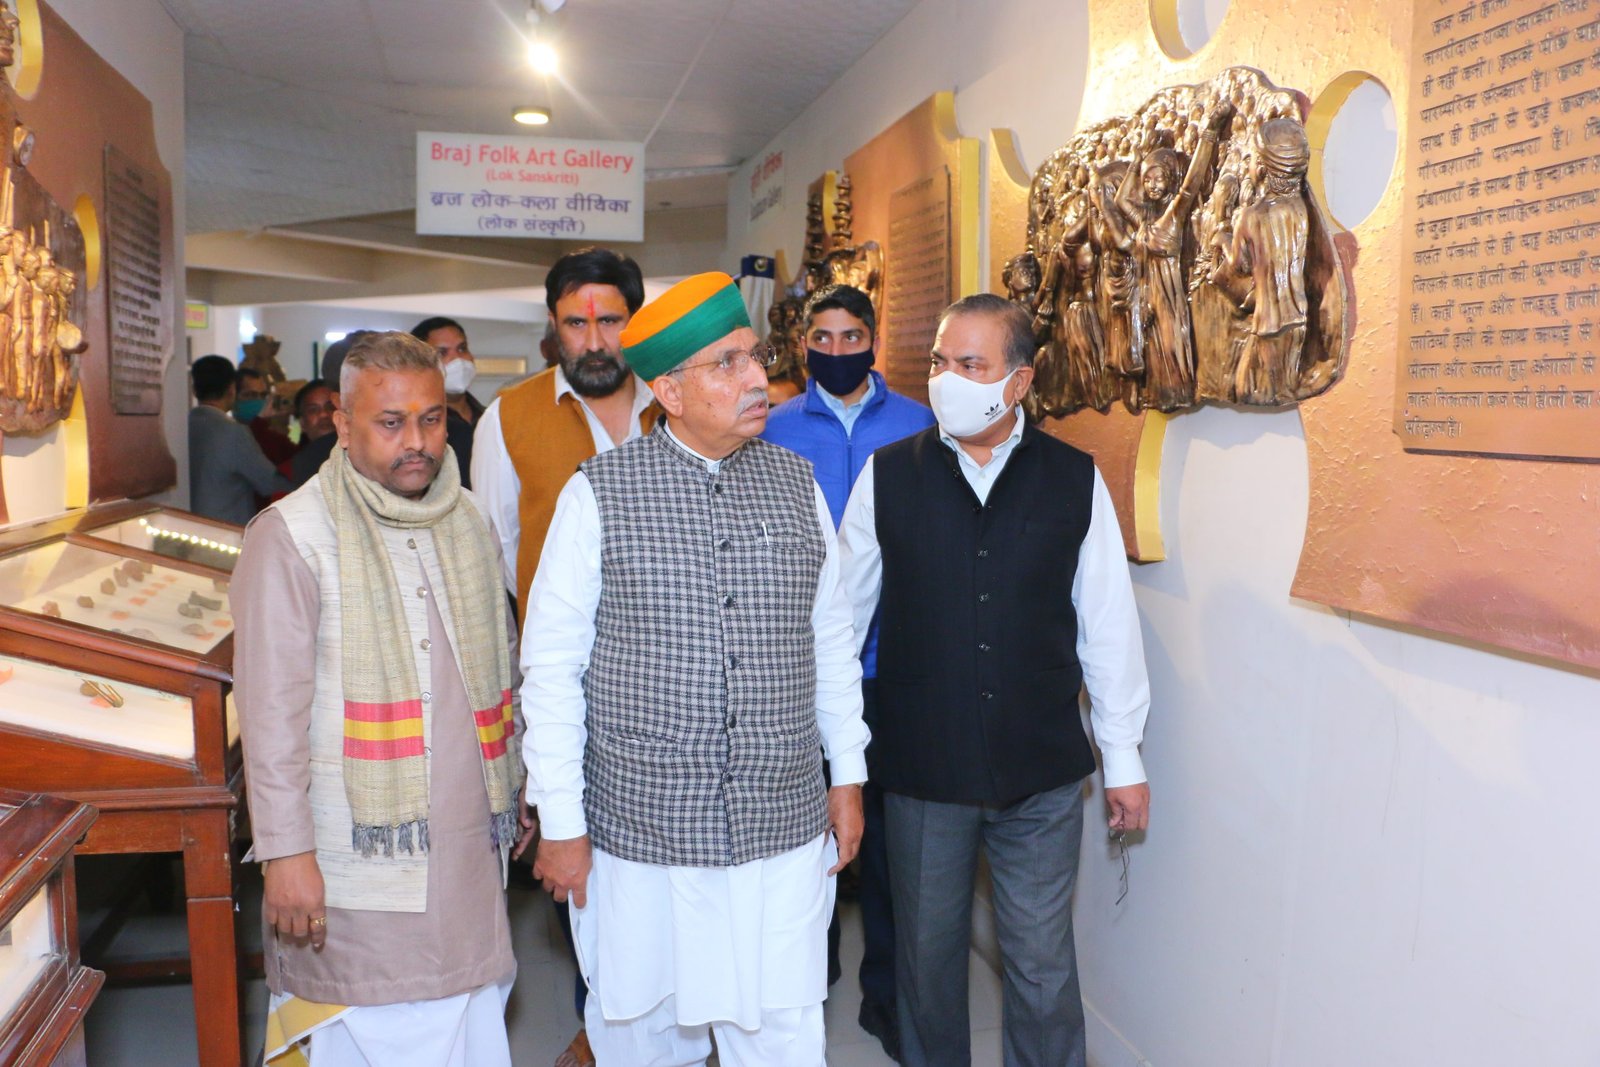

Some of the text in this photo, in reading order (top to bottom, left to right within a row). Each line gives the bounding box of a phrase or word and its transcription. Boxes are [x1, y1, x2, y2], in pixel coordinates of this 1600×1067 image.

[1422, 75, 1433, 98] ही
[1437, 66, 1458, 92] नहीं
[1419, 132, 1444, 152] साथ
[1450, 123, 1462, 145] ही
[1468, 112, 1499, 140] होली
[430, 142, 634, 173] Braj Folk Art Gallery
[1492, 136, 1541, 163] परम्परा
[485, 169, 579, 186] (Lok Sanskriti)
[1484, 174, 1511, 195] साथ
[1515, 166, 1528, 190] ही
[430, 191, 464, 207] ब्रज
[565, 191, 632, 213] वीथिका
[477, 213, 585, 236] (लोक संस्कृति)
[1501, 230, 1515, 254] ही
[1546, 219, 1600, 245] आयोज
[1452, 271, 1474, 291] बाद
[1476, 262, 1504, 288] होली
[1489, 292, 1515, 315] और
[1499, 327, 1528, 345] साथ
[1443, 356, 1467, 377] और
[1535, 384, 1567, 408] होली
